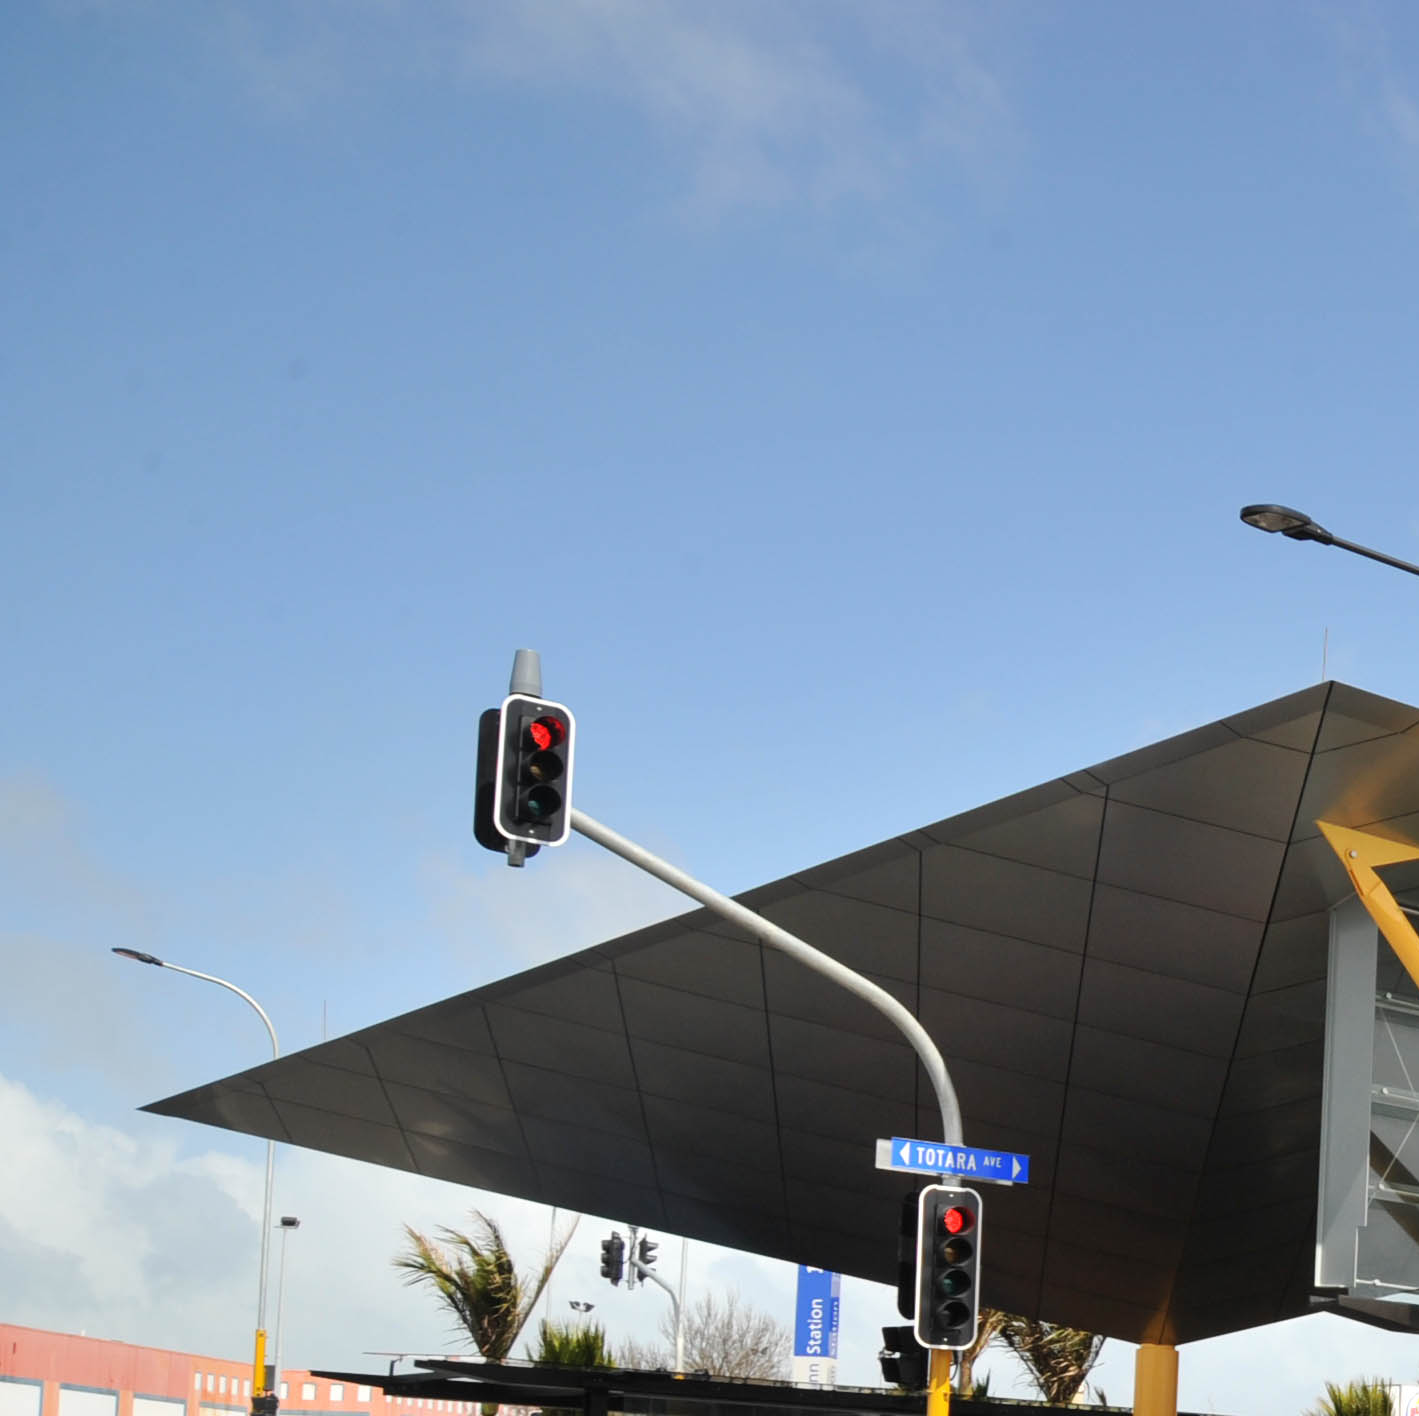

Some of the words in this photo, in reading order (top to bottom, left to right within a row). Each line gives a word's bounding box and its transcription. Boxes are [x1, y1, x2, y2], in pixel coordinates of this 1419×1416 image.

[916, 1147, 977, 1171] TOTARA
[983, 1157, 1002, 1168] AVE
[805, 1298, 823, 1355] Station
